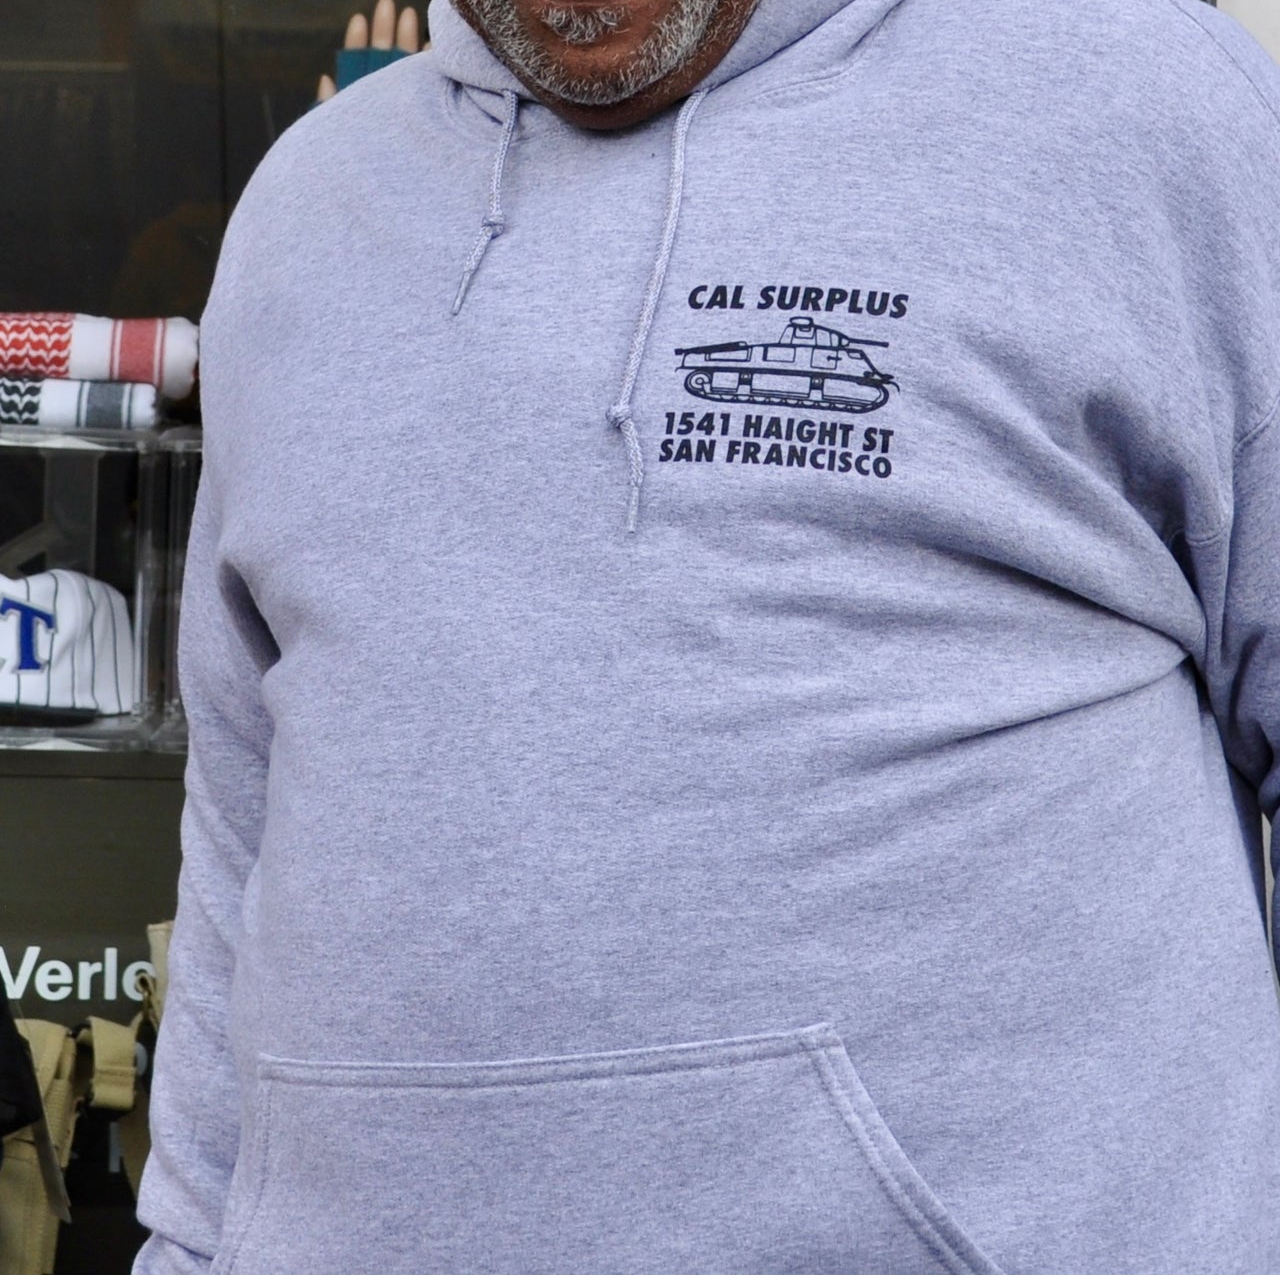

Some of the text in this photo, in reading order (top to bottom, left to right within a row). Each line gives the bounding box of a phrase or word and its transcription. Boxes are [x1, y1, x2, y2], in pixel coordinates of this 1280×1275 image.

[687, 284, 909, 319] CAL SURPLUS
[664, 411, 894, 454] 1541 HAIGHT ST
[658, 438, 893, 479] SAN FRANCISCO
